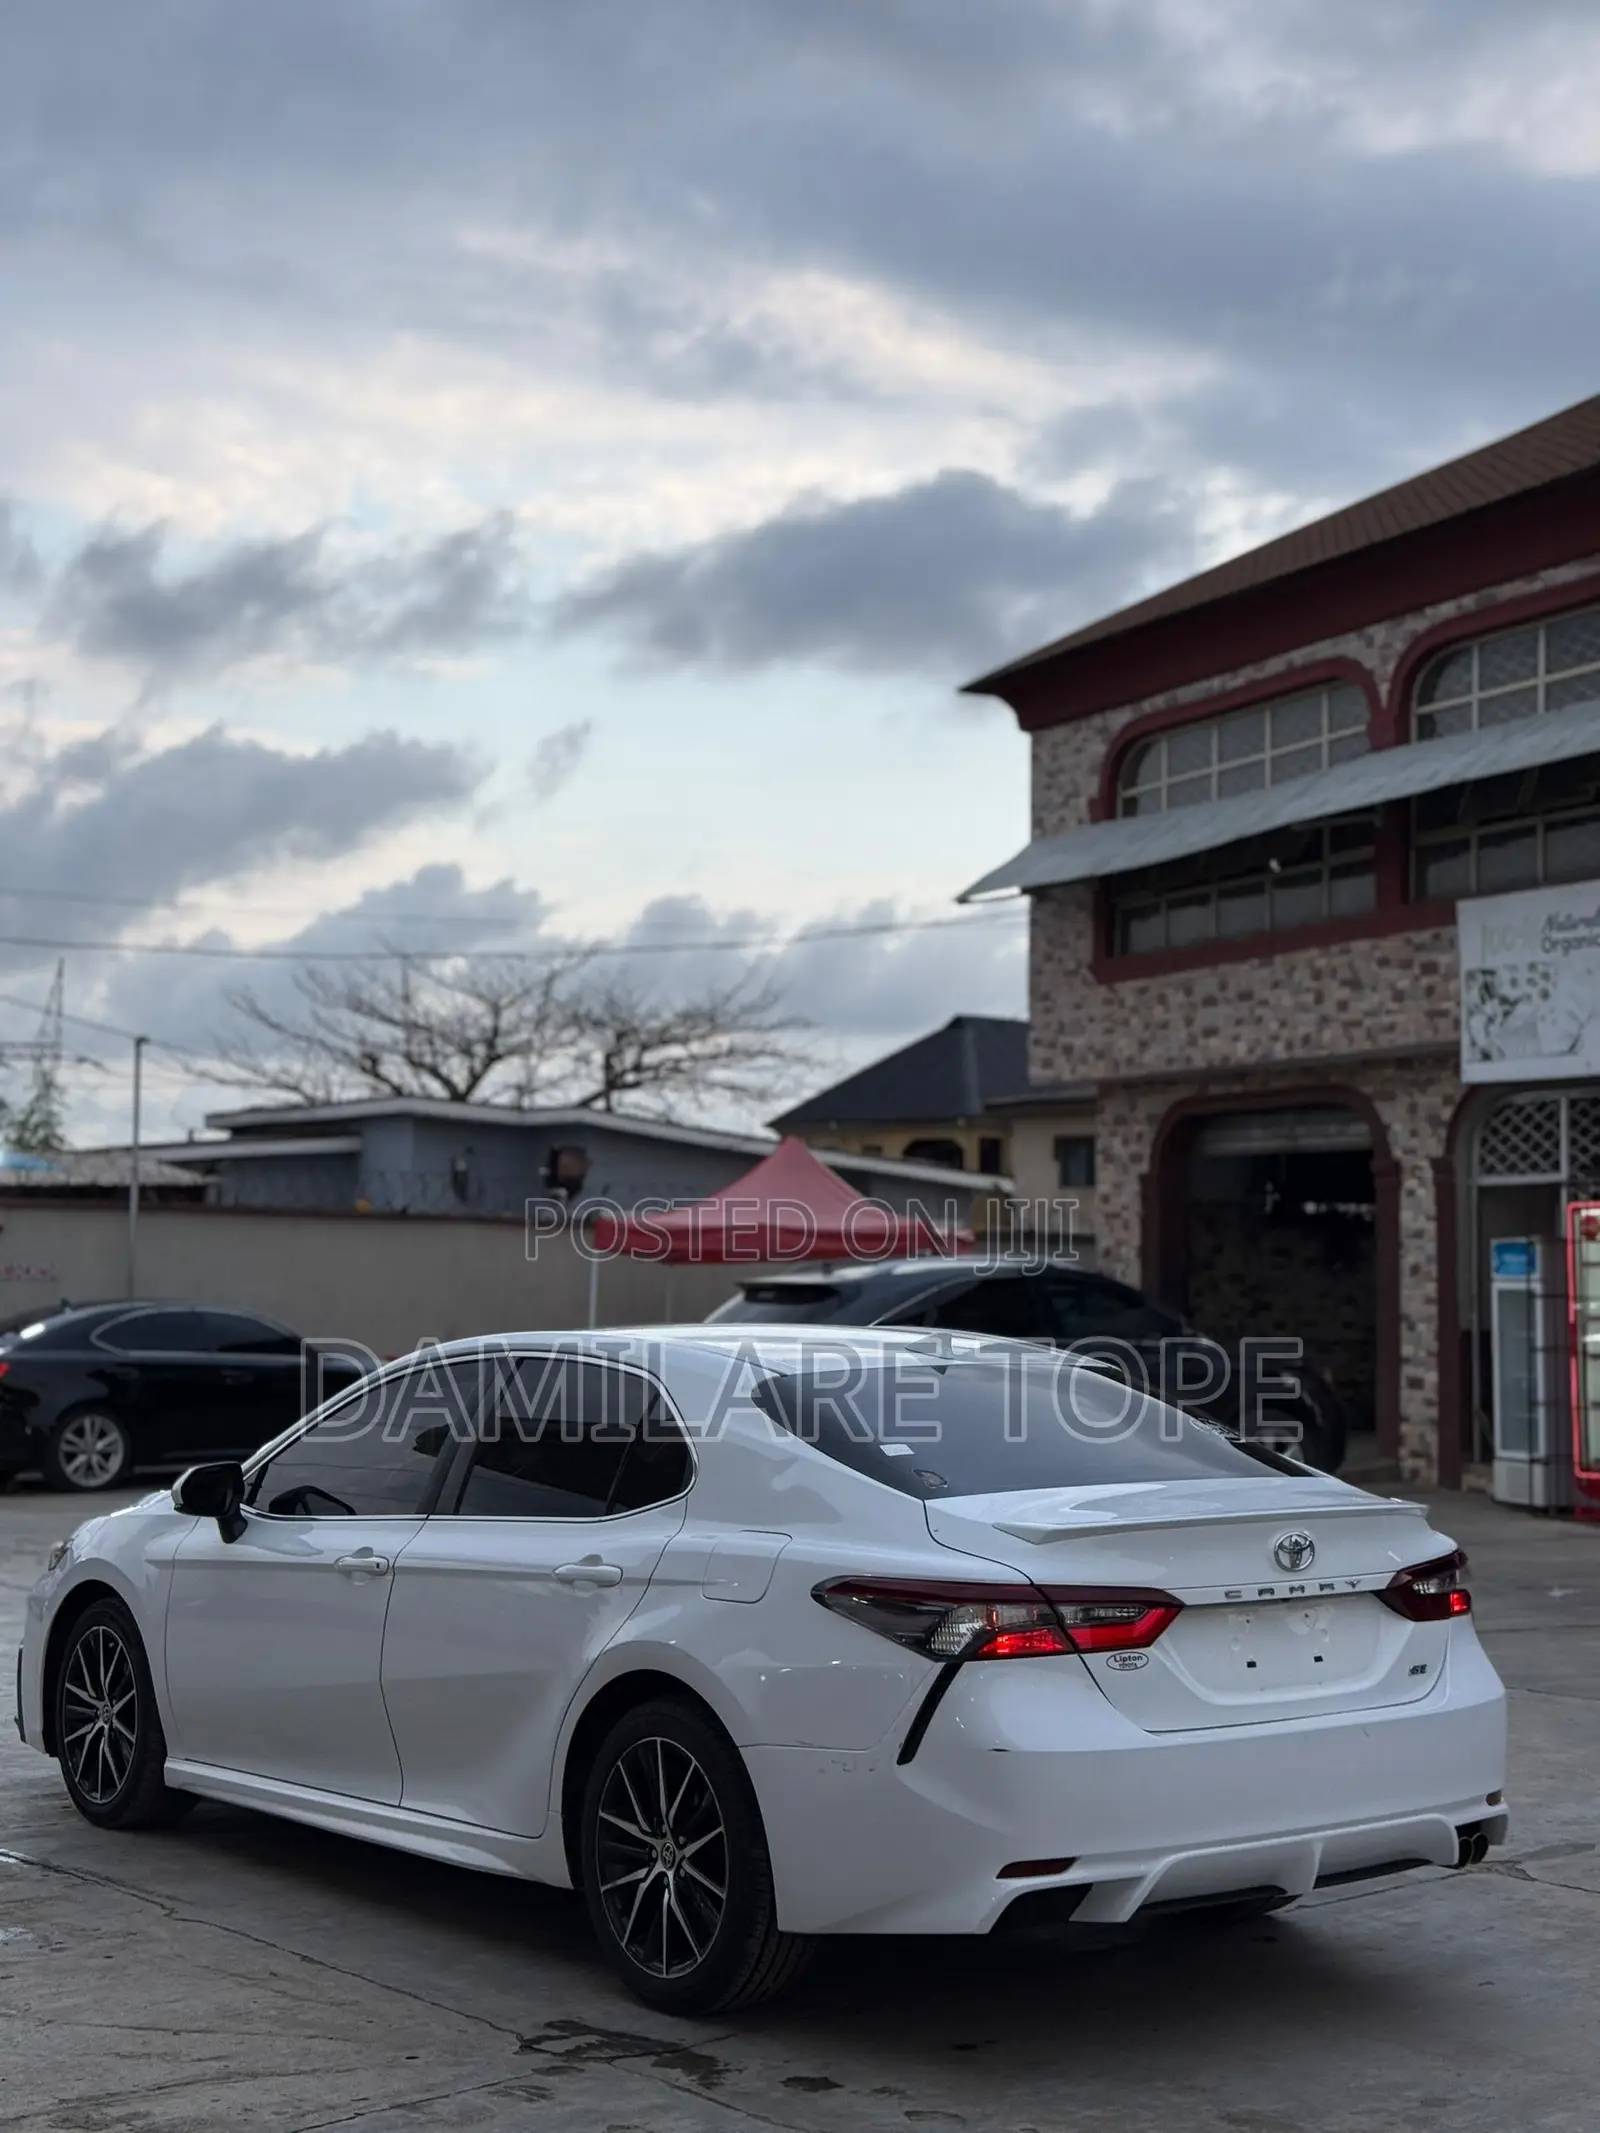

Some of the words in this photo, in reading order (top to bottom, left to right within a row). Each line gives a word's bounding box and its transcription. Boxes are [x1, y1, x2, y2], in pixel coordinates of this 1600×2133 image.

[1224, 1579, 1361, 1599] CAMRY
[1113, 1654, 1143, 1663] Lipton
[1408, 1664, 1428, 1676] SE
